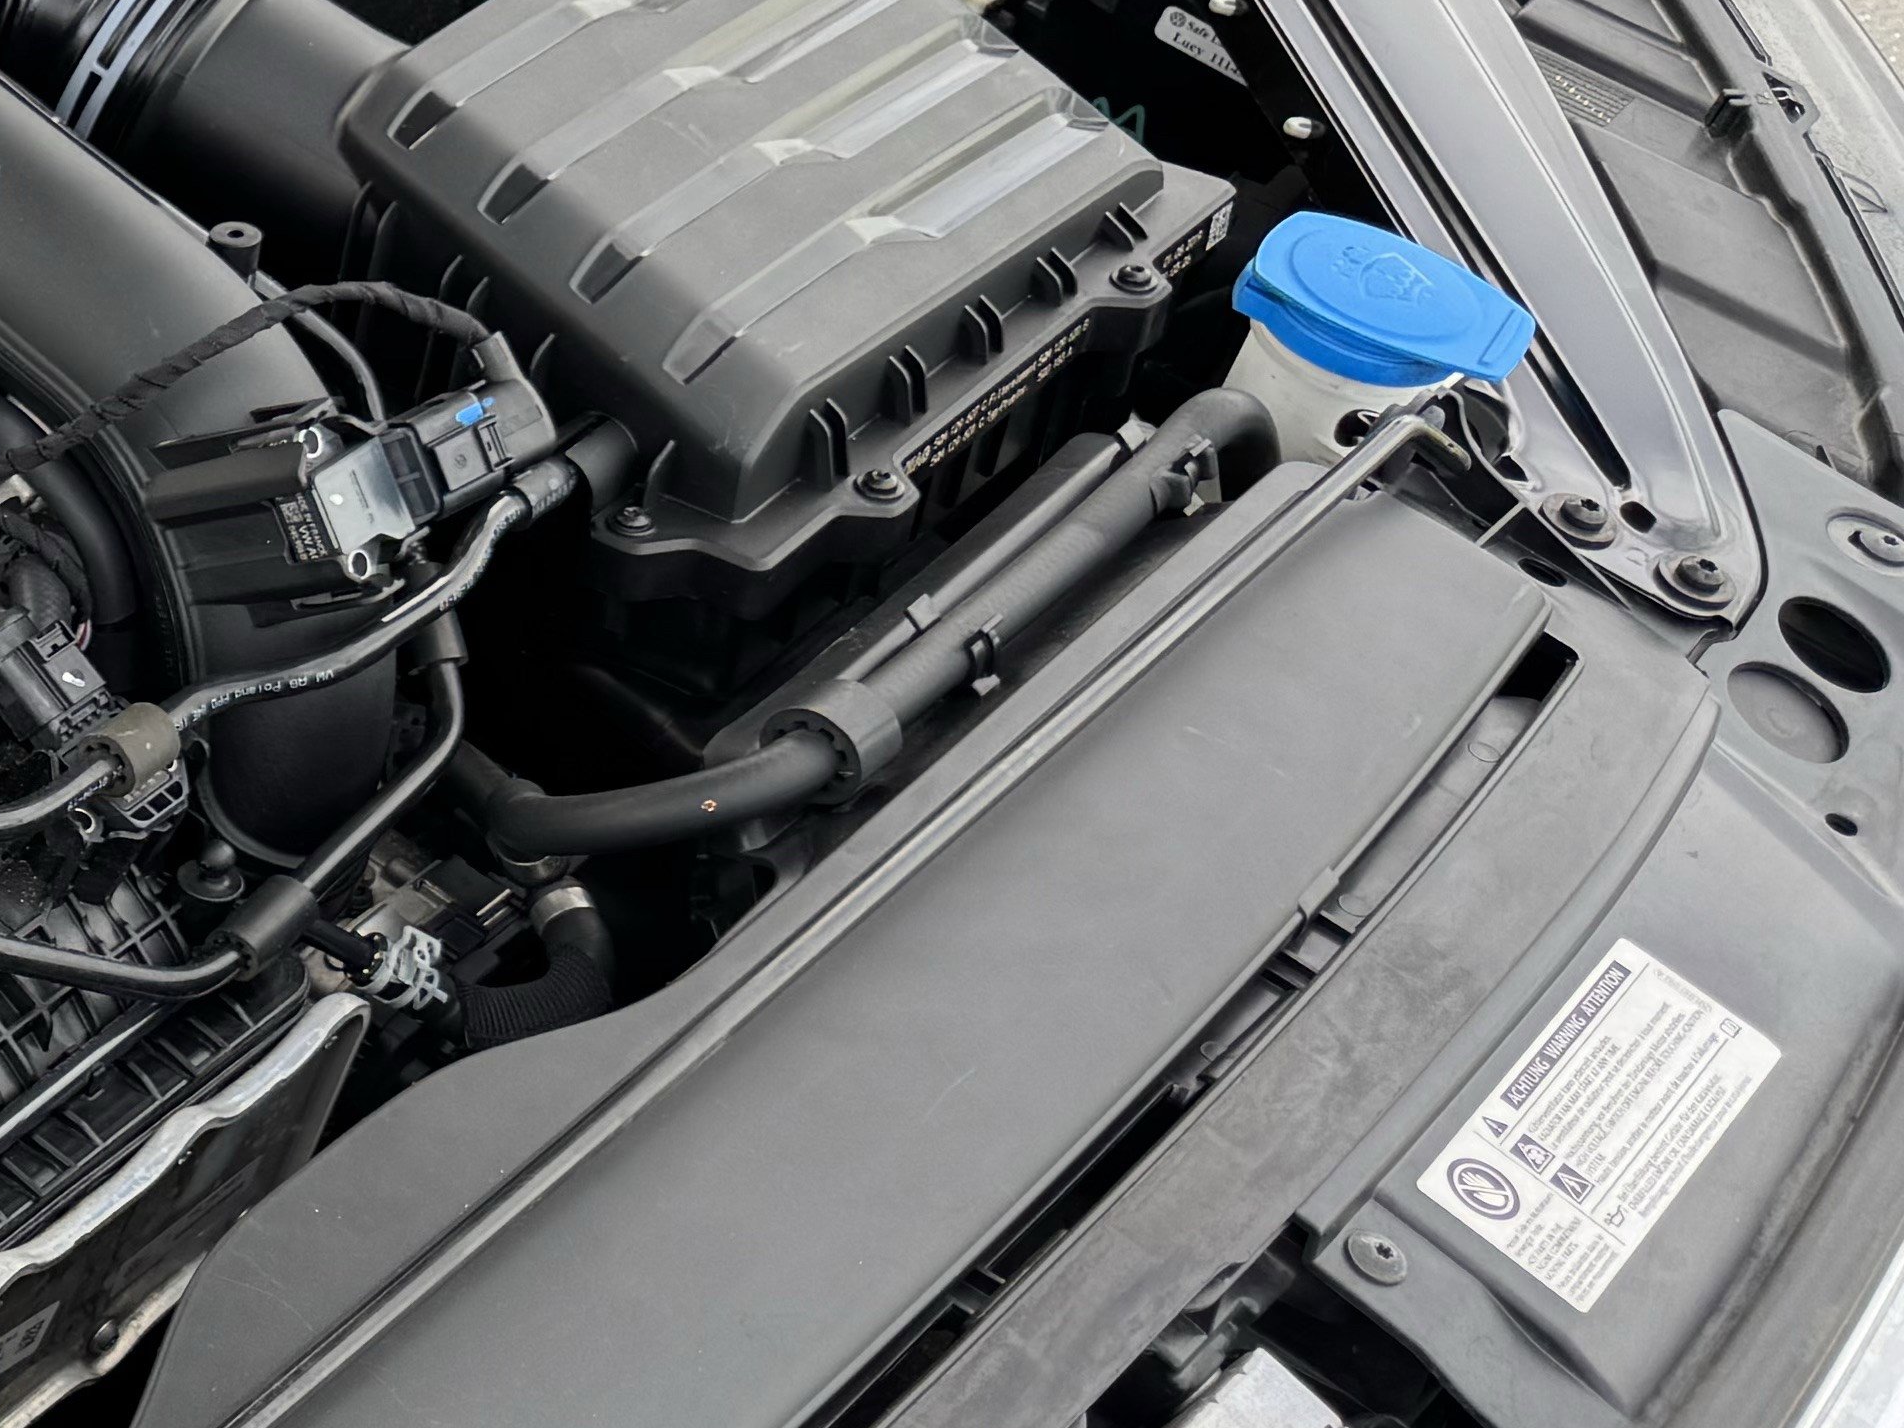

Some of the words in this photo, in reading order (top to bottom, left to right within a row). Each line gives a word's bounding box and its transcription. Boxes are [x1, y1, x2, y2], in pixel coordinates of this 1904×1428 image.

[1170, 31, 1204, 58] Lucy
[314, 669, 334, 683] VW
[233, 680, 282, 699] Poland
[1504, 1055, 1551, 1106] ACHTUNG
[1541, 1012, 1587, 1061] WARNING
[1577, 965, 1626, 1017] ATTENTION
